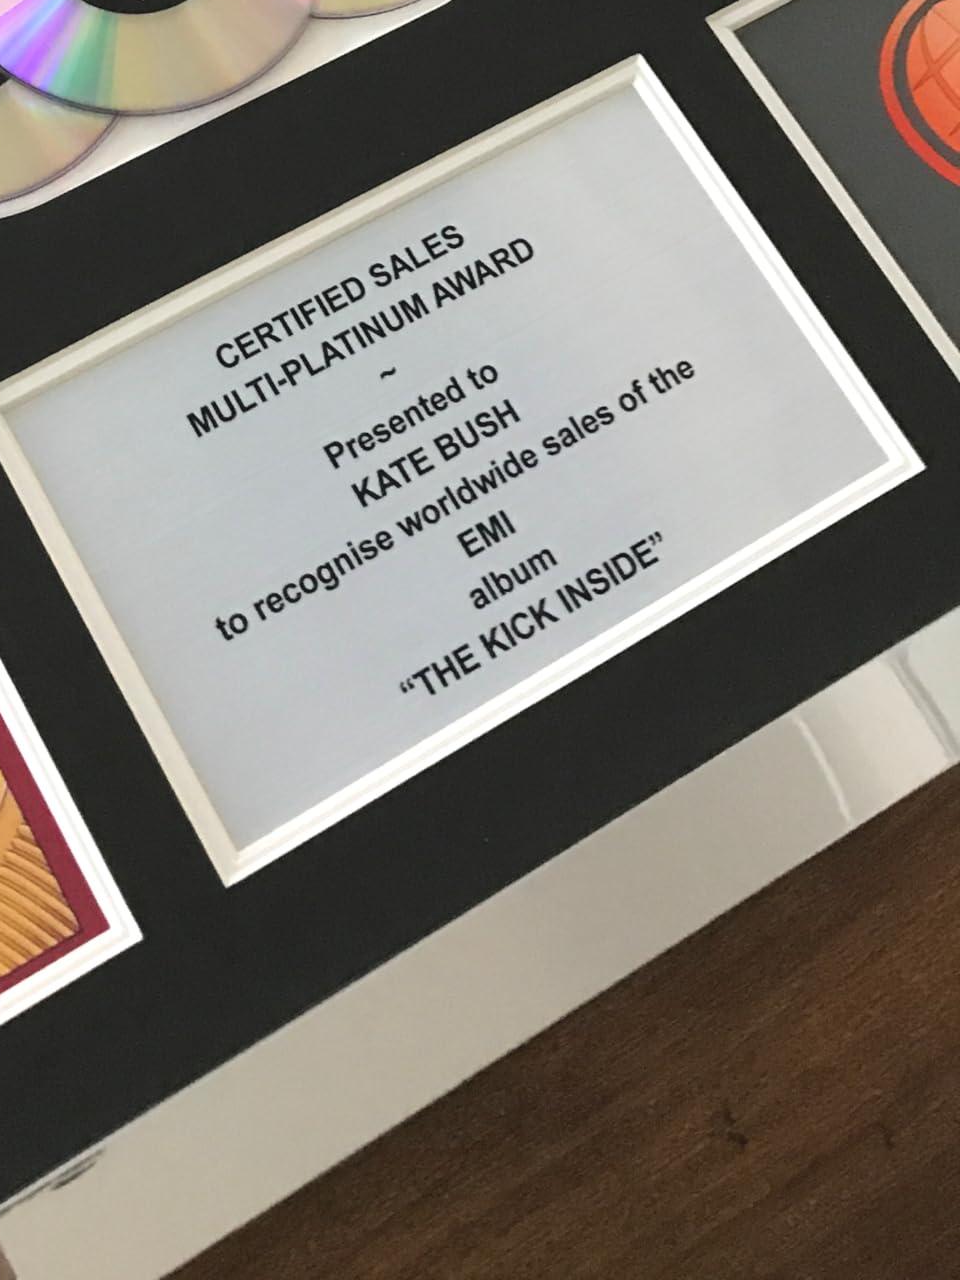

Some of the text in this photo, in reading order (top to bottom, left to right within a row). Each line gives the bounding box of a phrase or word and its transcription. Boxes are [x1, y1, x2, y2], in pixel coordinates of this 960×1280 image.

[186, 238, 534, 438] MULTI-PLATINUM AWARD
[215, 225, 465, 369] CERTIFIED SALES
[322, 364, 499, 470] Presented to
[350, 399, 521, 508] KATE BUSH
[215, 360, 695, 641] to recognise worldwide sales of the
[456, 509, 517, 559] EMI
[469, 548, 558, 610] album
[478, 597, 560, 660] KICK
